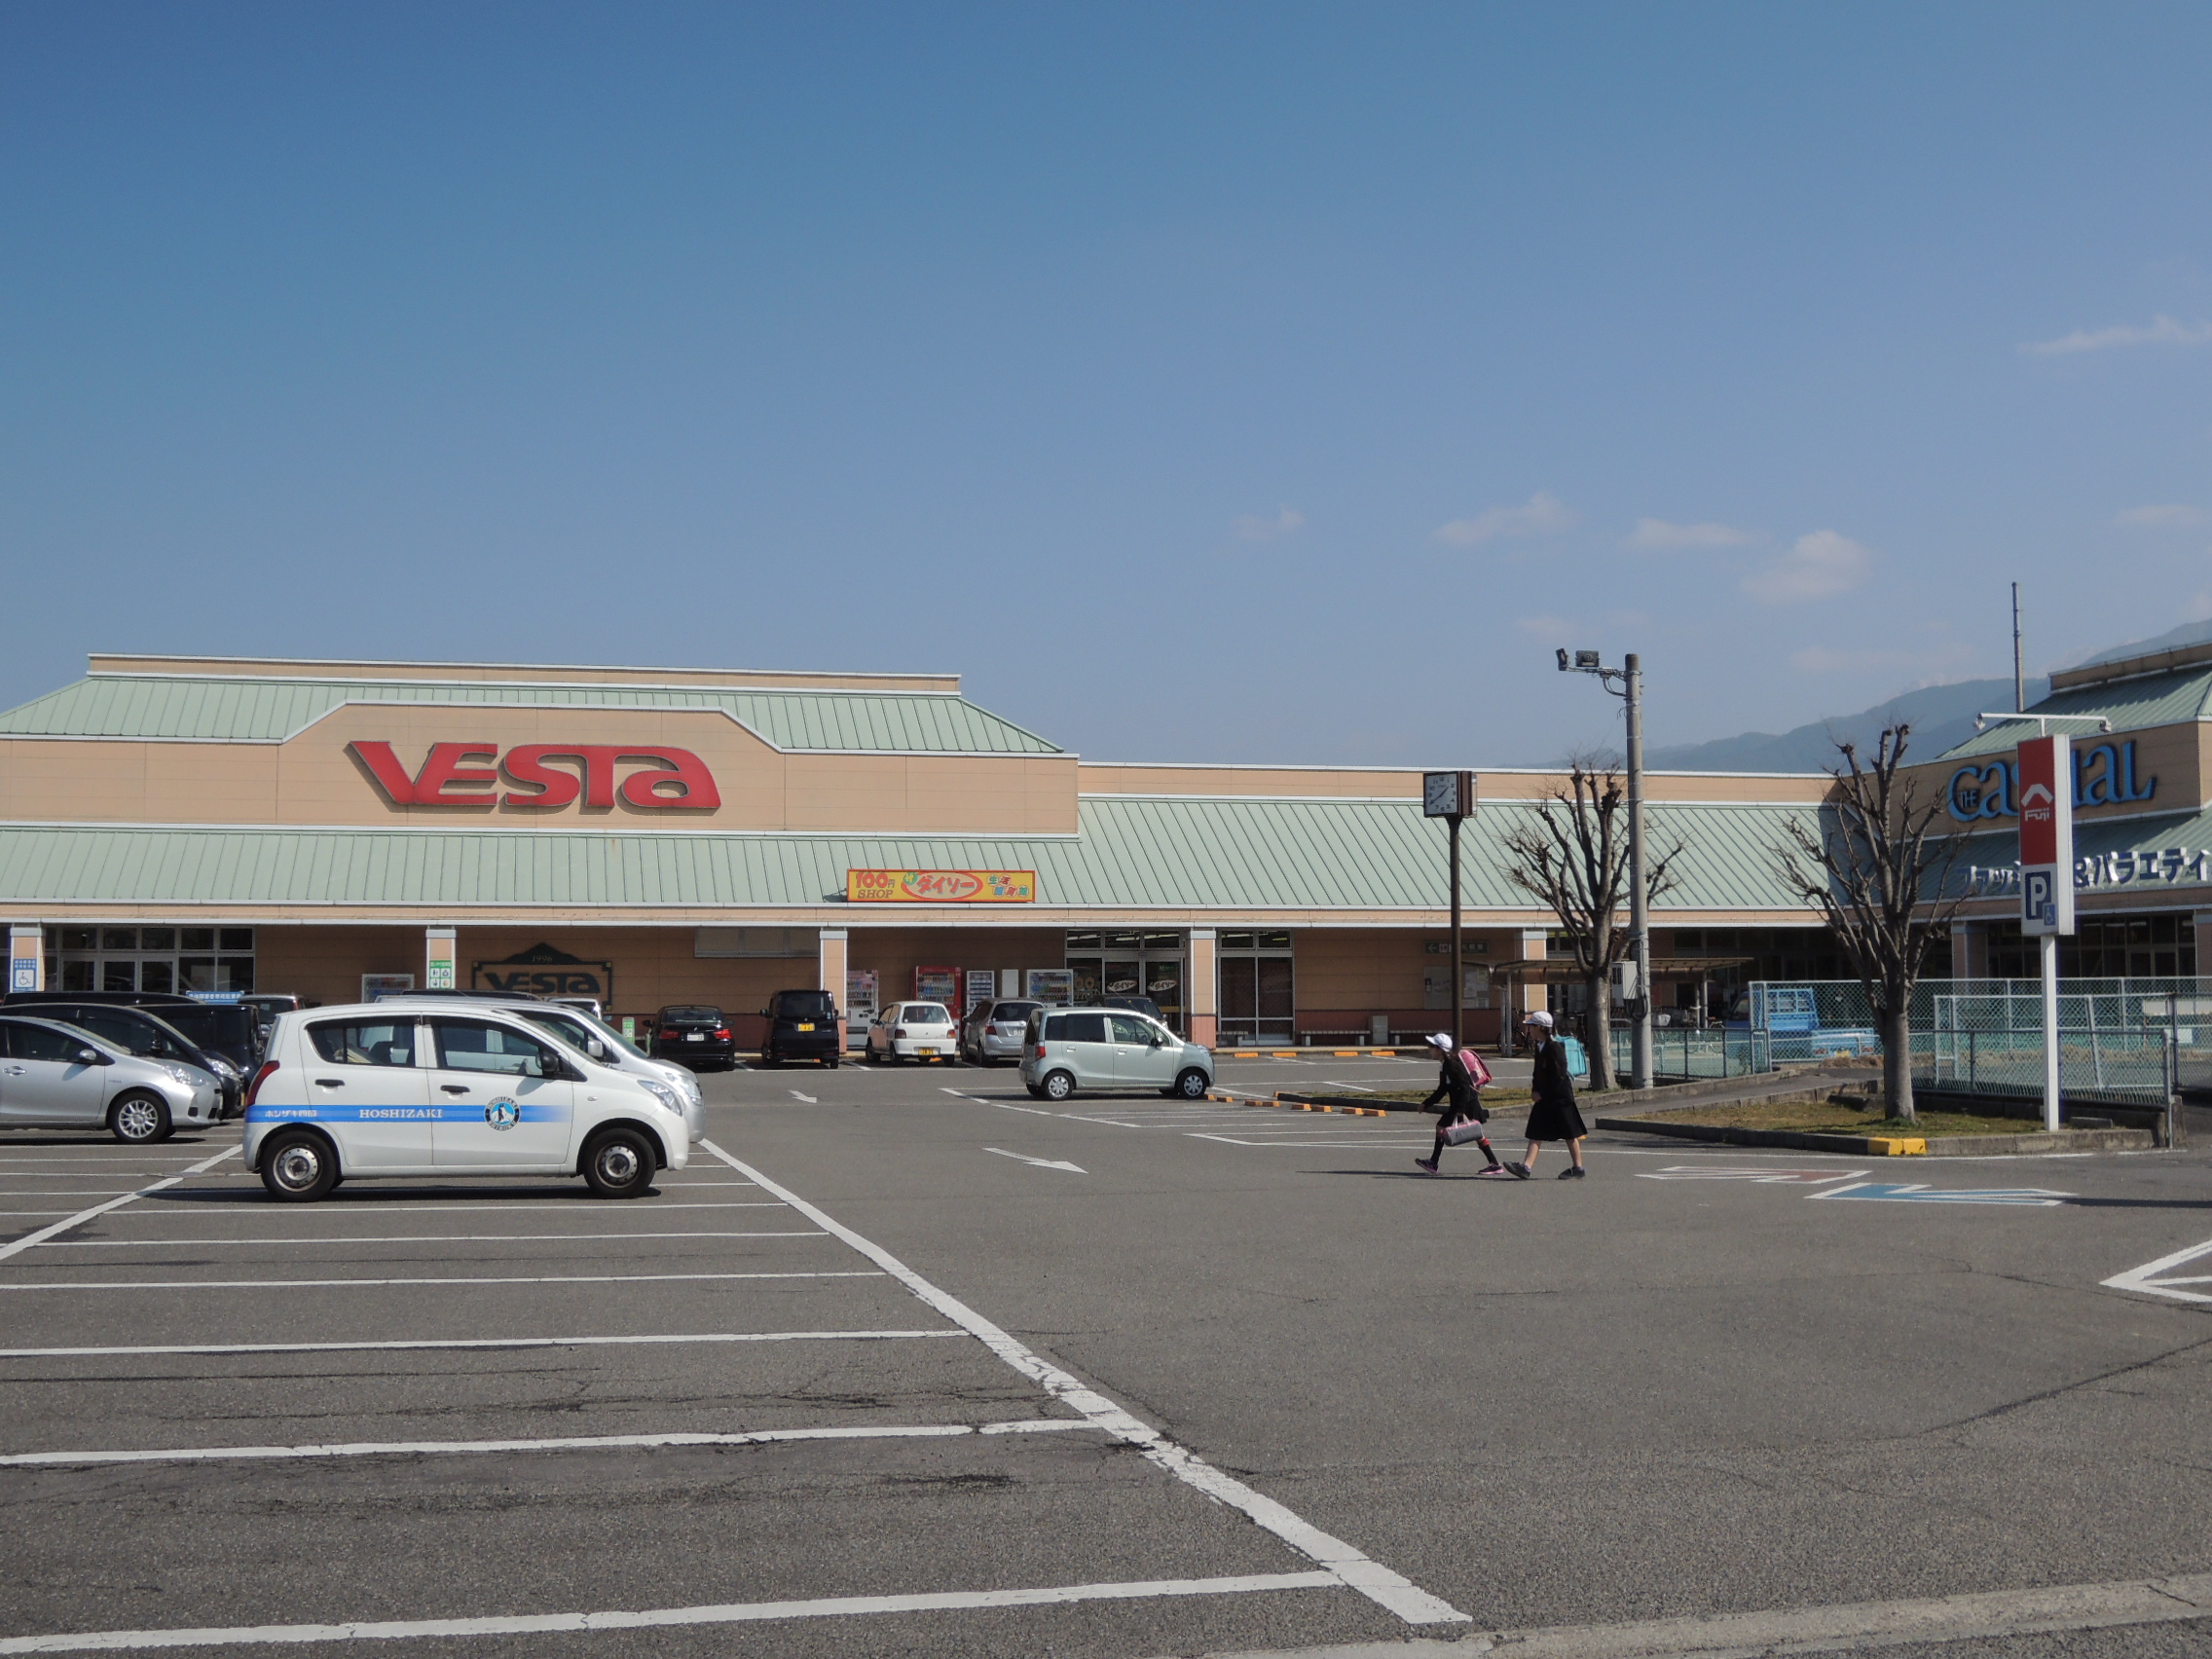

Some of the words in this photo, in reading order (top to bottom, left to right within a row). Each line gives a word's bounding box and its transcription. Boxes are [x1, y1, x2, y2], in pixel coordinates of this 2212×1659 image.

[1958, 789, 1978, 808] THE
[857, 889, 894, 899] SHOP
[916, 874, 976, 895] ダイソー
[2030, 875, 2046, 917] P
[359, 1108, 443, 1119] HOSHIZAKI
